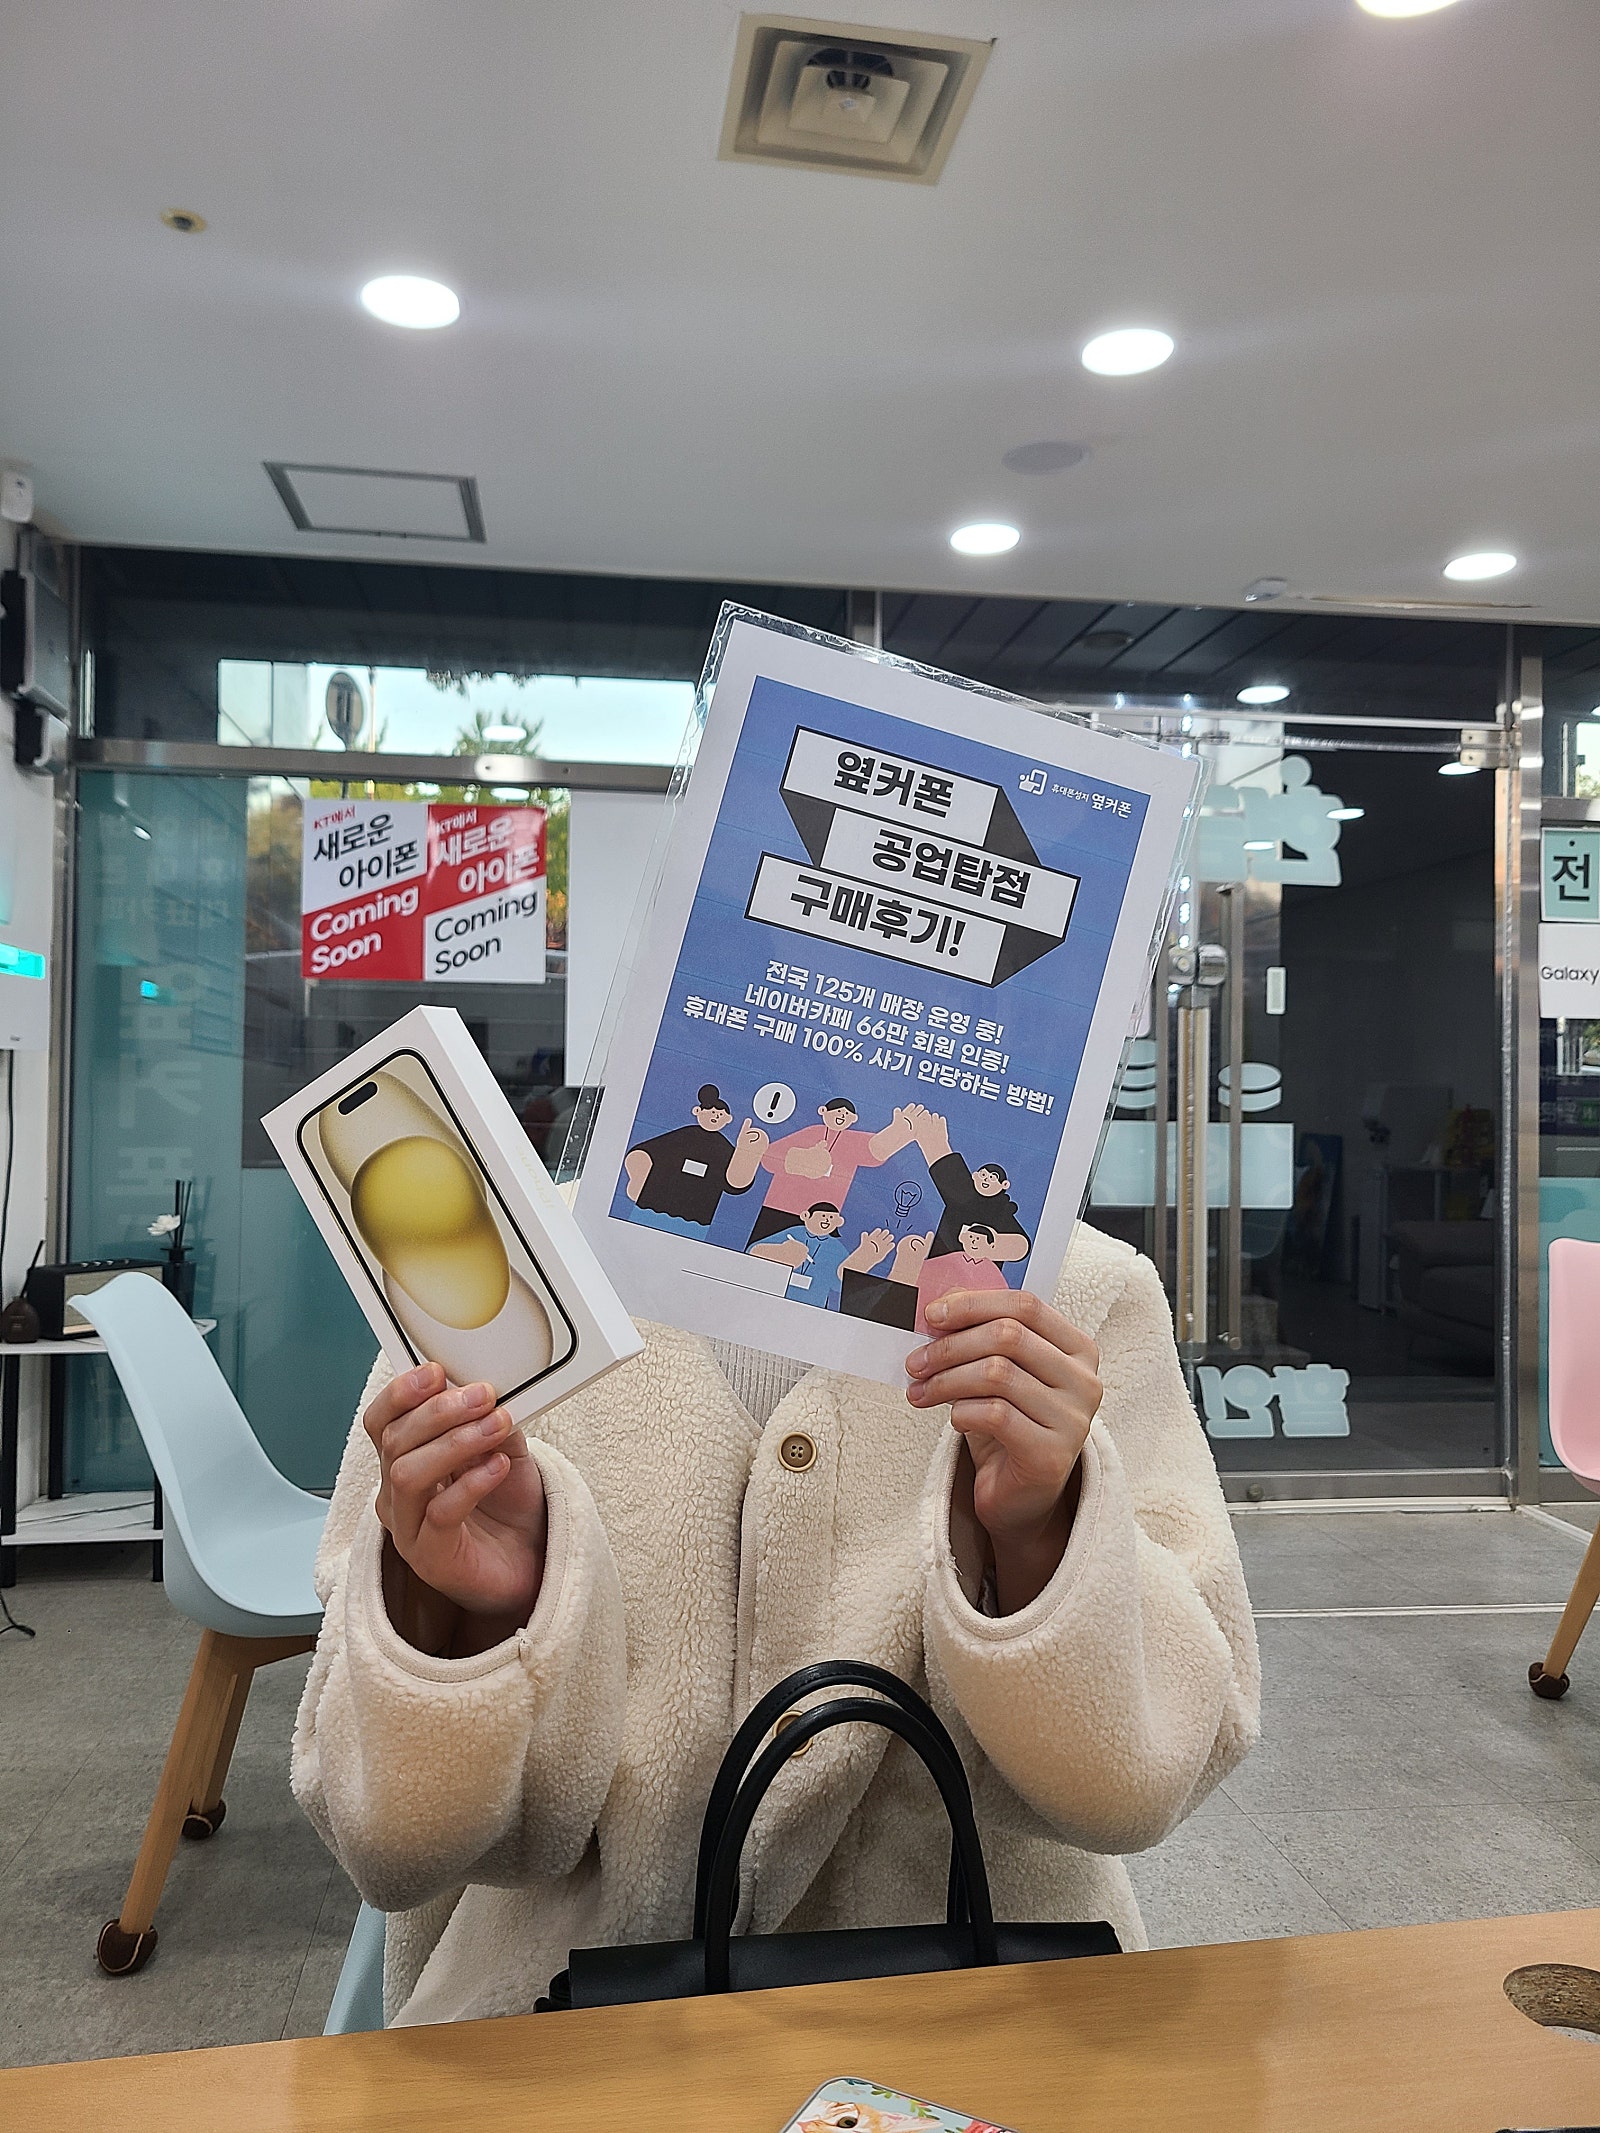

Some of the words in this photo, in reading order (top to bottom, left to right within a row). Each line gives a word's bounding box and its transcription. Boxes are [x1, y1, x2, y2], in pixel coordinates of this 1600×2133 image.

[833, 750, 954, 819] 옆커폰
[1092, 793, 1132, 818] 옆커폰
[314, 805, 356, 829] KT에서
[314, 813, 394, 862] 새로운
[436, 808, 478, 834] KT에서
[436, 814, 515, 867] 새로운
[339, 840, 420, 889] 아이폰
[458, 842, 540, 894] 아이폰
[872, 829, 1032, 910] 공업탑점
[1551, 854, 1590, 901] 전
[310, 885, 419, 942] Coming
[435, 892, 538, 942] Coming
[790, 874, 968, 958] 구매후기!
[311, 932, 382, 974] Soon
[436, 936, 501, 974] Soon
[1541, 966, 1599, 985] Galaxy
[766, 960, 810, 990] 전국
[814, 973, 877, 1014] 125개
[879, 992, 924, 1022] 매장
[926, 1006, 971, 1036] 운영
[975, 1019, 1005, 1046] 중!
[744, 983, 854, 1032] 네이버카페
[856, 1014, 910, 1047] 66만
[912, 1030, 956, 1060] 회원
[960, 1043, 1011, 1075] 인증!
[682, 994, 750, 1032] 휴대폰
[753, 1014, 796, 1044] 구매
[802, 1028, 864, 1064] 100%
[869, 1046, 916, 1076] 사기
[916, 1058, 1003, 1101] 안당하는
[1005, 1083, 1055, 1116] 방법!
